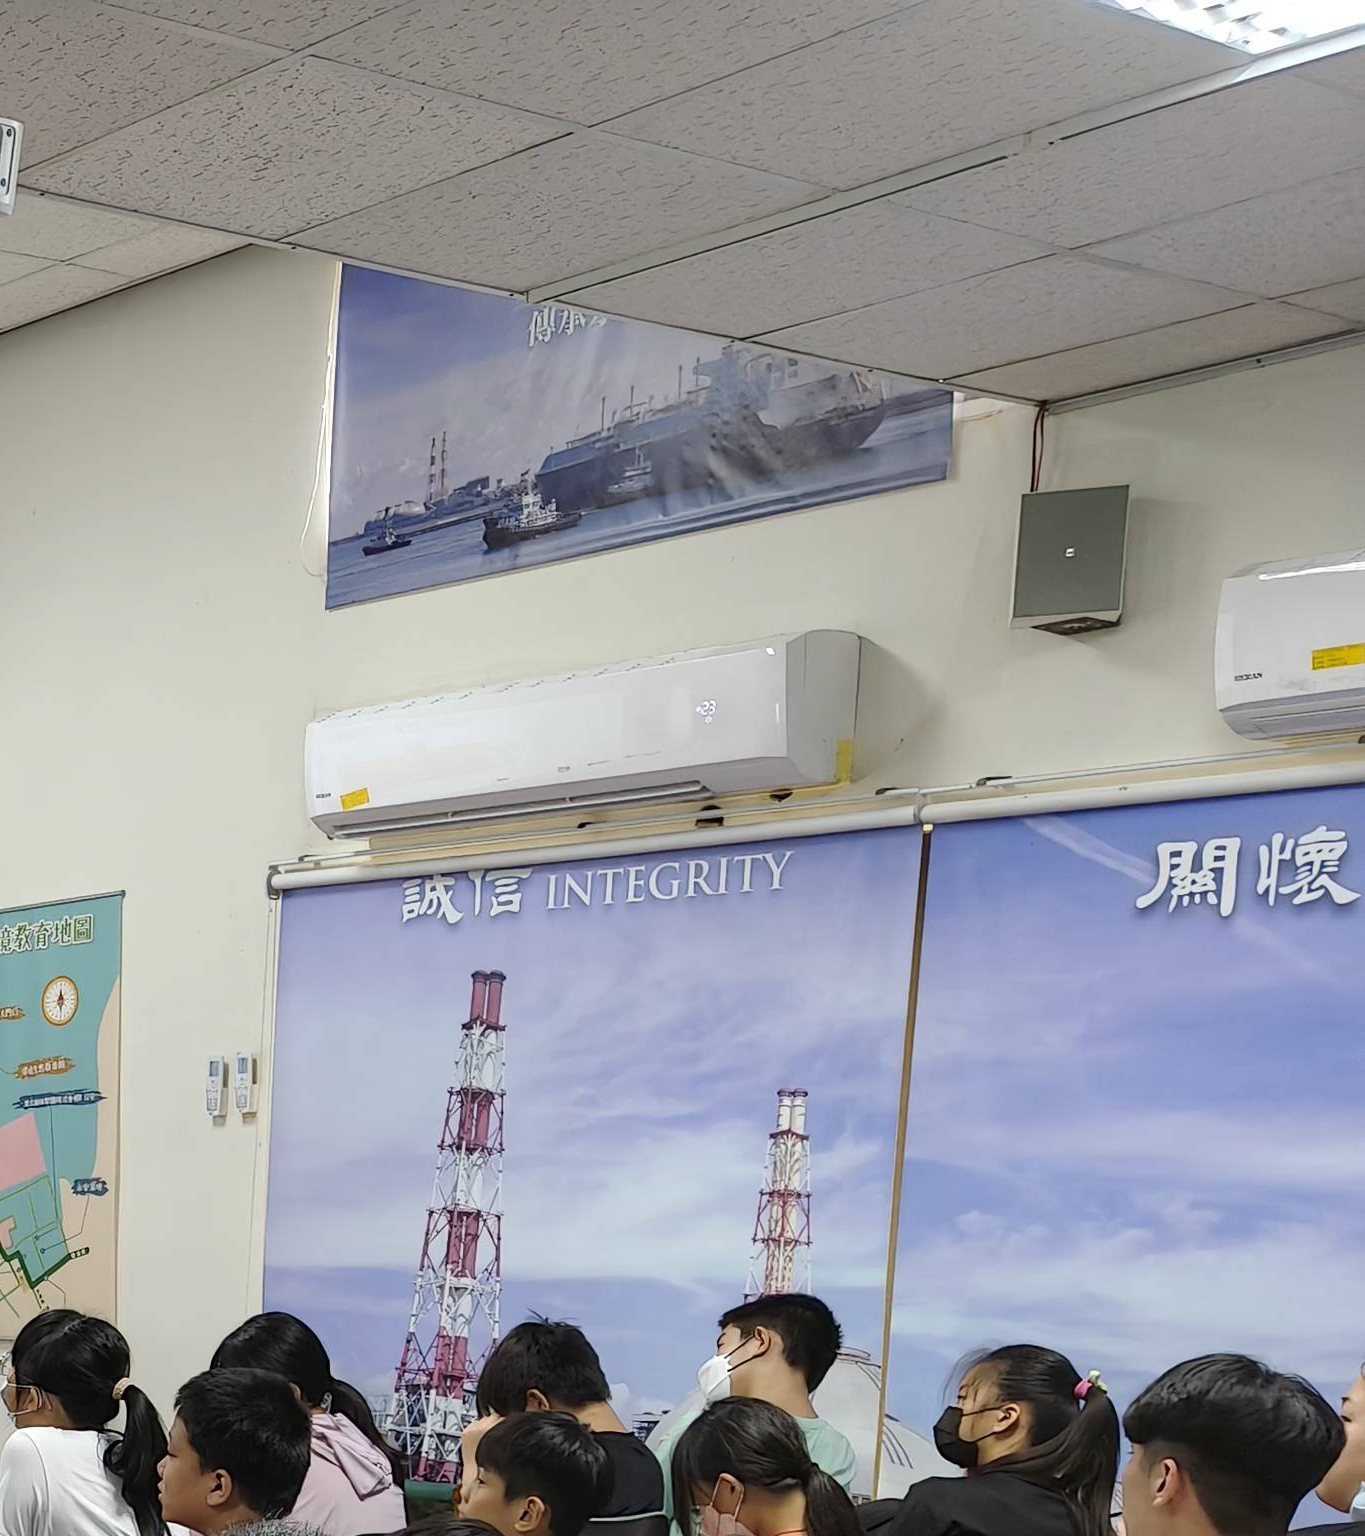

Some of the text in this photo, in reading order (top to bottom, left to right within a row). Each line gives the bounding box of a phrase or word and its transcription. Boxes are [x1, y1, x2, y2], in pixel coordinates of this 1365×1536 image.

[401, 850, 795, 925] 誠信 INTEGRITY
[1135, 825, 1362, 917] 關懷
